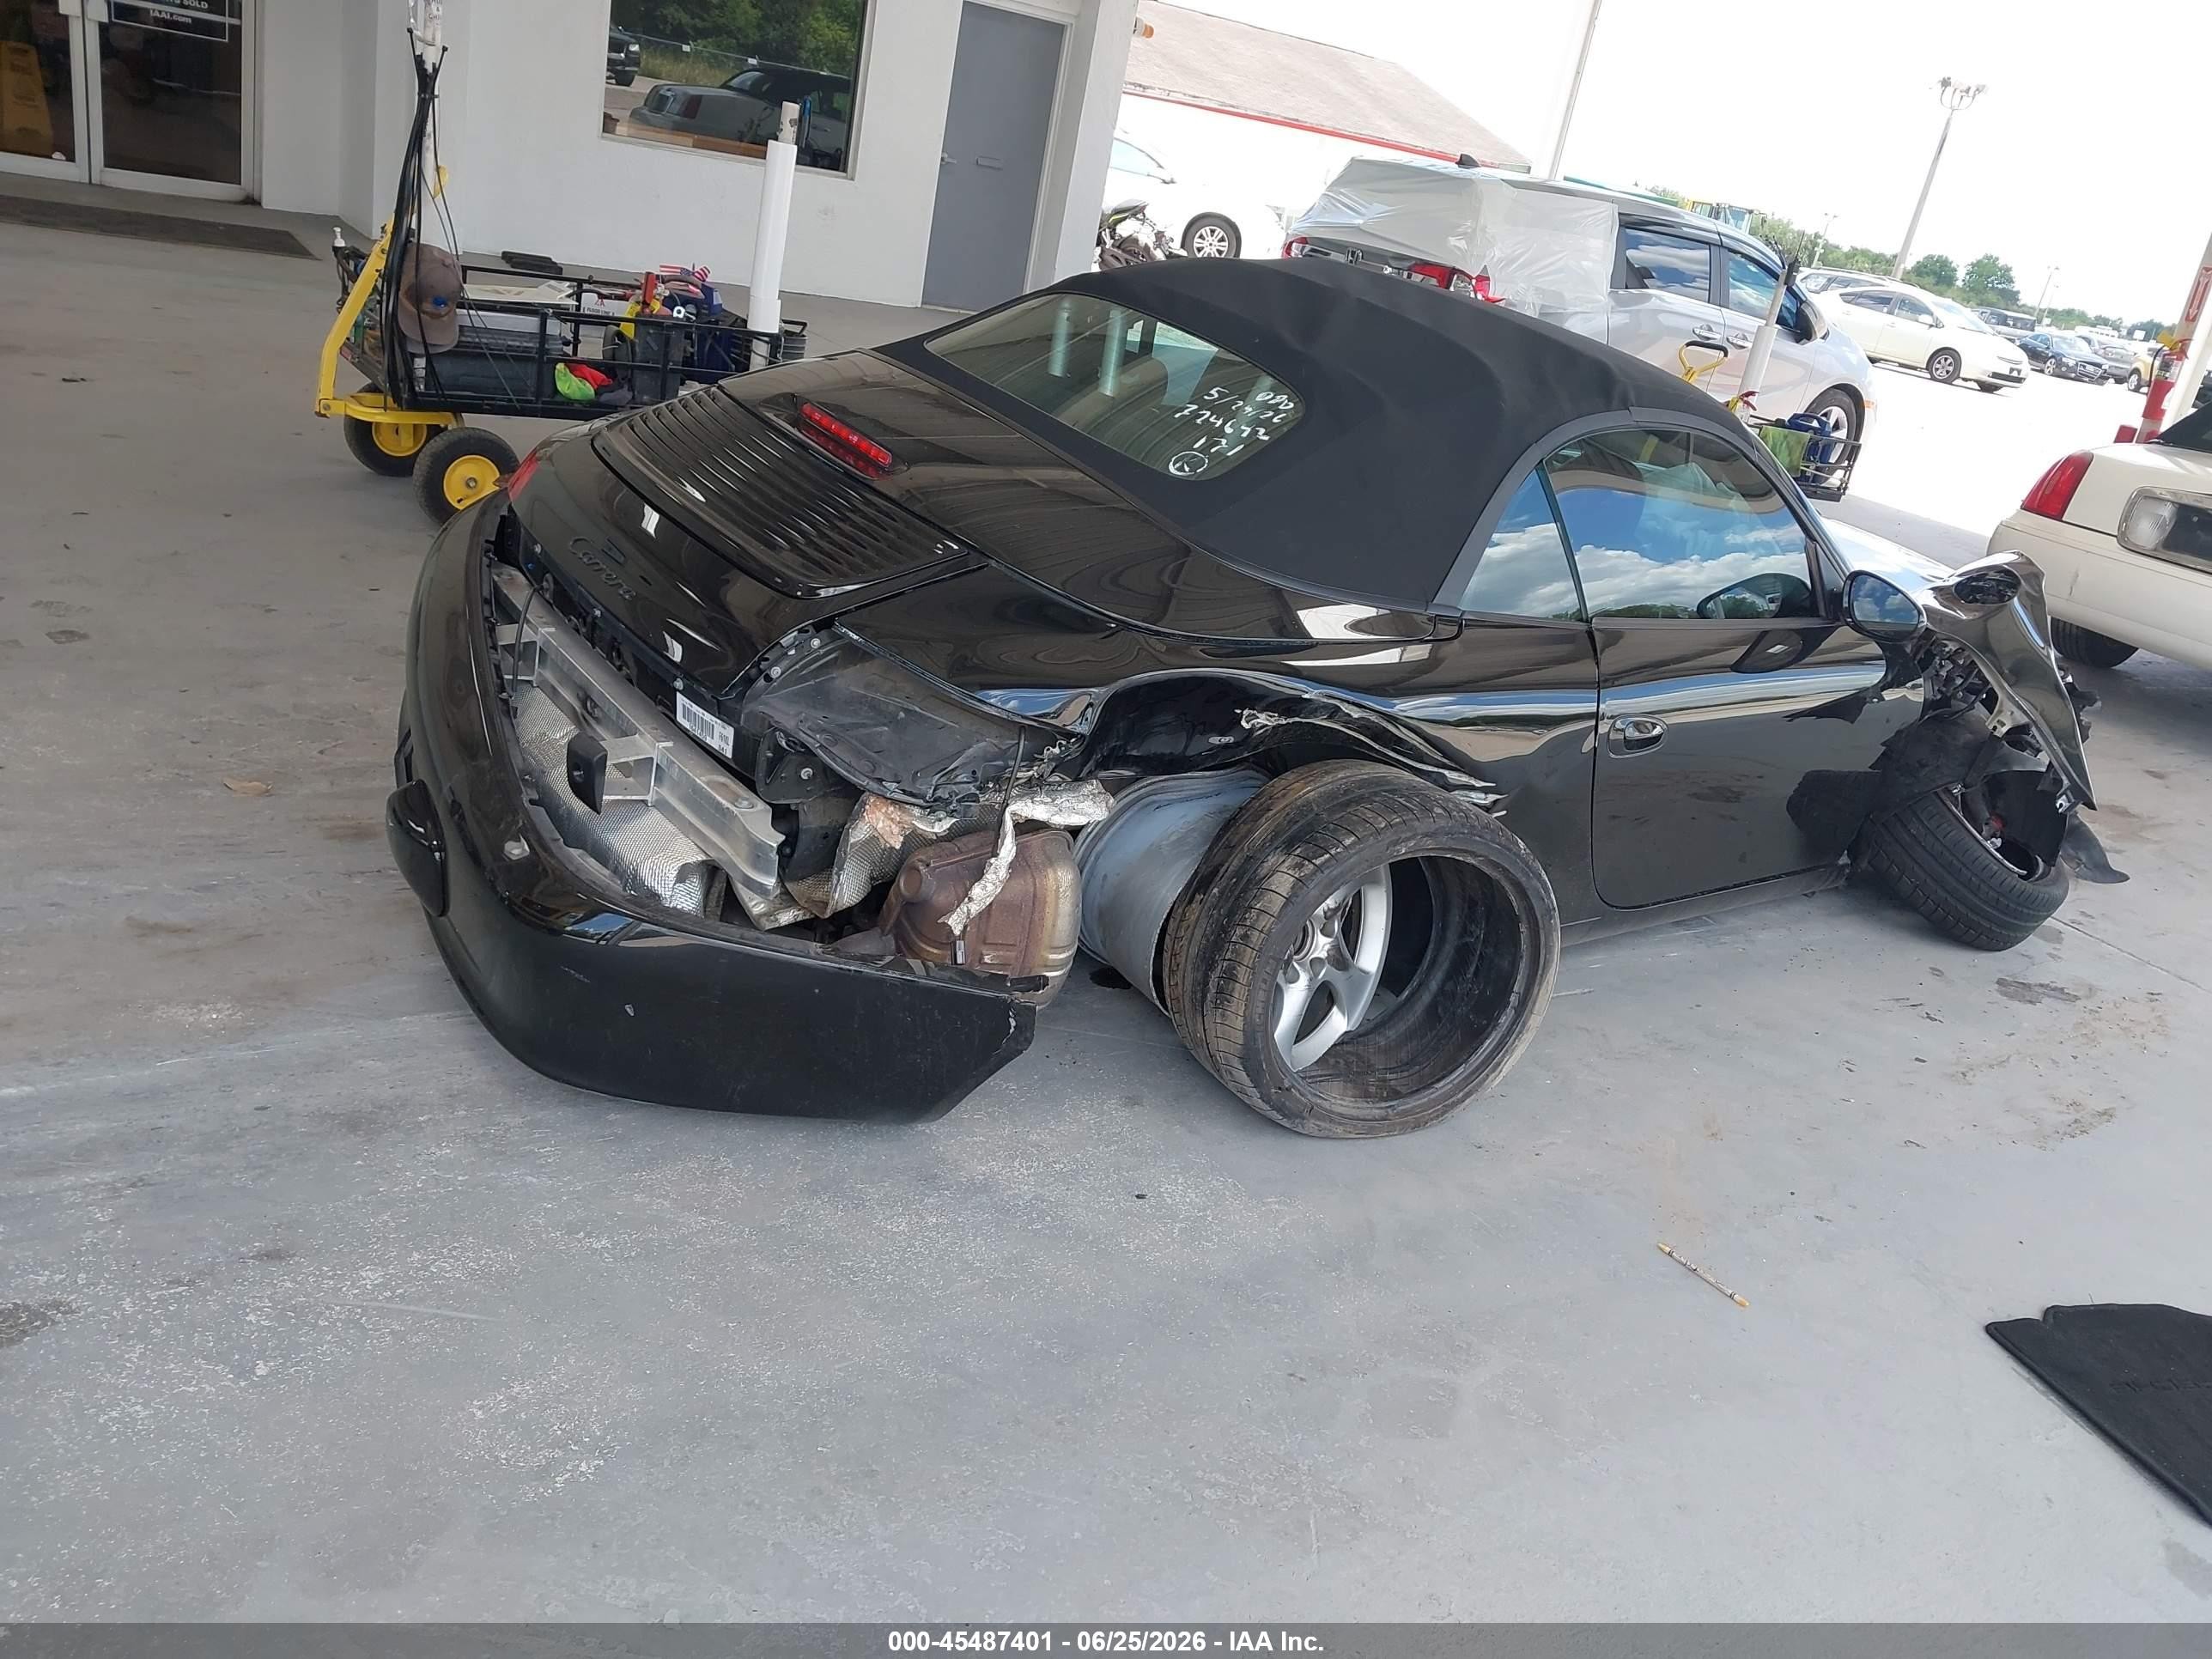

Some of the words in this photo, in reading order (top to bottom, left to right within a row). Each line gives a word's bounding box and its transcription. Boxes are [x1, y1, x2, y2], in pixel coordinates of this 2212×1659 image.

[183, 0, 209, 9] SOLD
[149, 9, 192, 24] IAAI.com
[569, 536, 636, 600] Carrera
